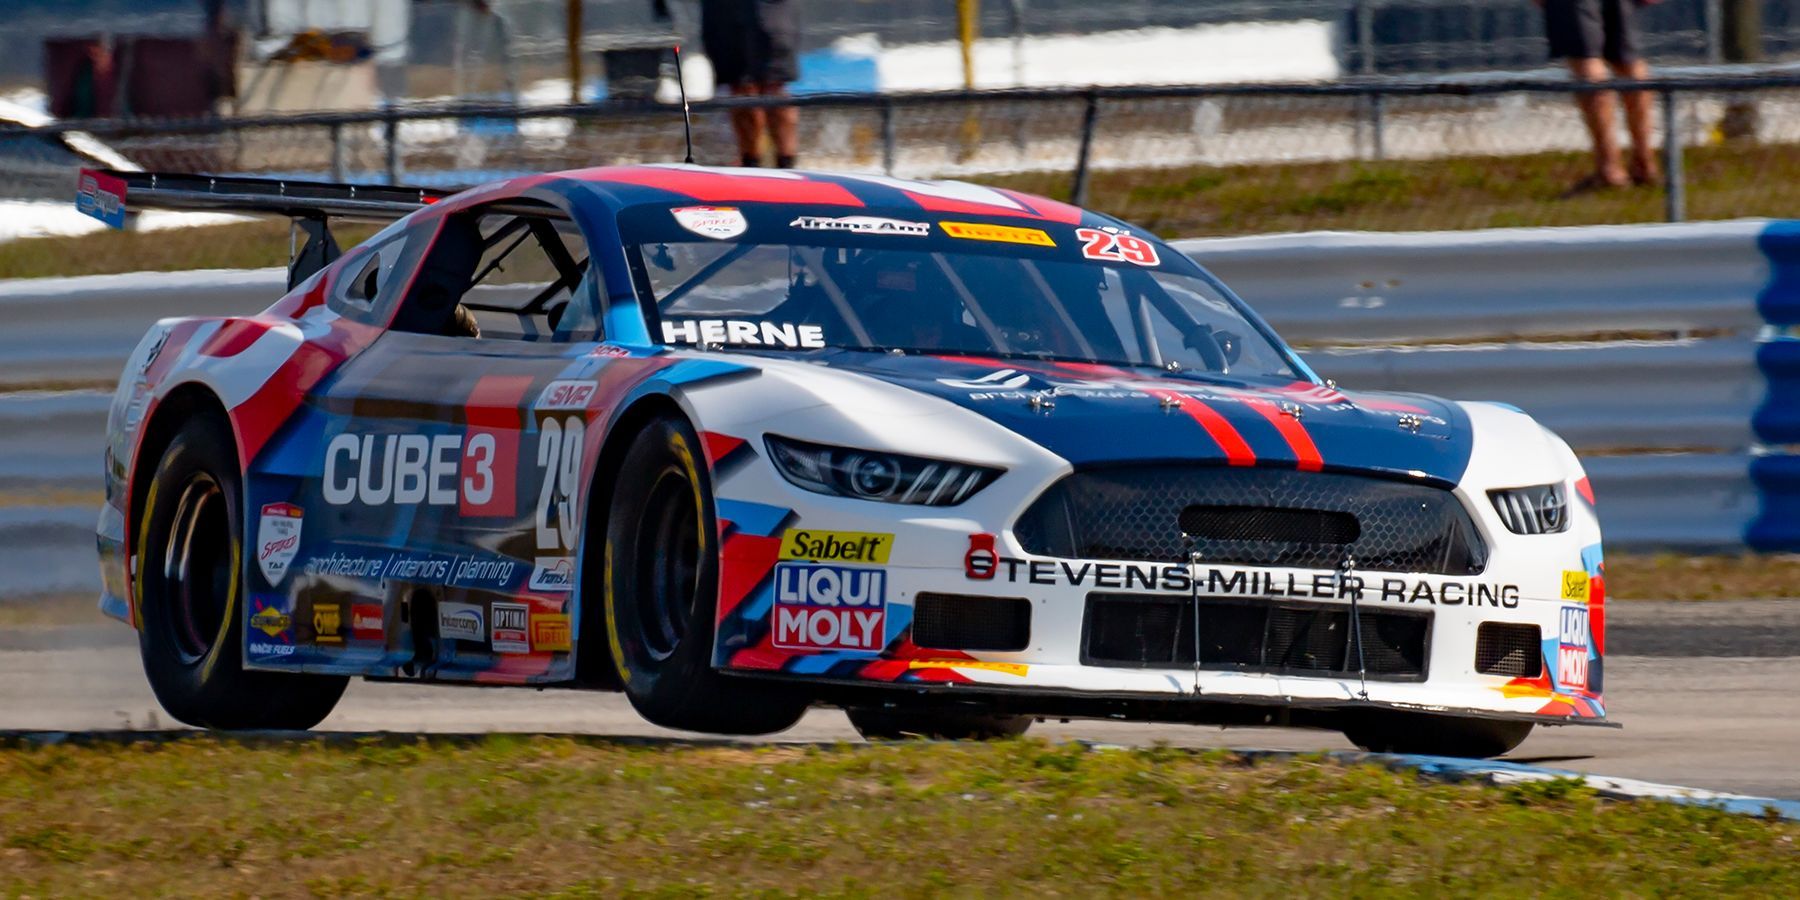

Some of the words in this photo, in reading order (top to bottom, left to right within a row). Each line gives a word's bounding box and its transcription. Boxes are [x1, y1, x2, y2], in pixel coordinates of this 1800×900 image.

[1075, 228, 1161, 267] 29
[660, 319, 826, 349] HERNE
[322, 433, 496, 506] CUBE3
[536, 415, 585, 551] 29
[790, 531, 882, 562] Sabelt
[305, 552, 383, 577] architecture
[389, 556, 449, 580] interiors
[452, 554, 516, 586] planning
[779, 567, 882, 607] LIQUI
[1382, 577, 1520, 609] RACING
[494, 610, 525, 628] OPTIMA
[777, 607, 884, 648] MOLY
[1560, 607, 1589, 647] LIQUI
[1559, 649, 1589, 687] MOLY
